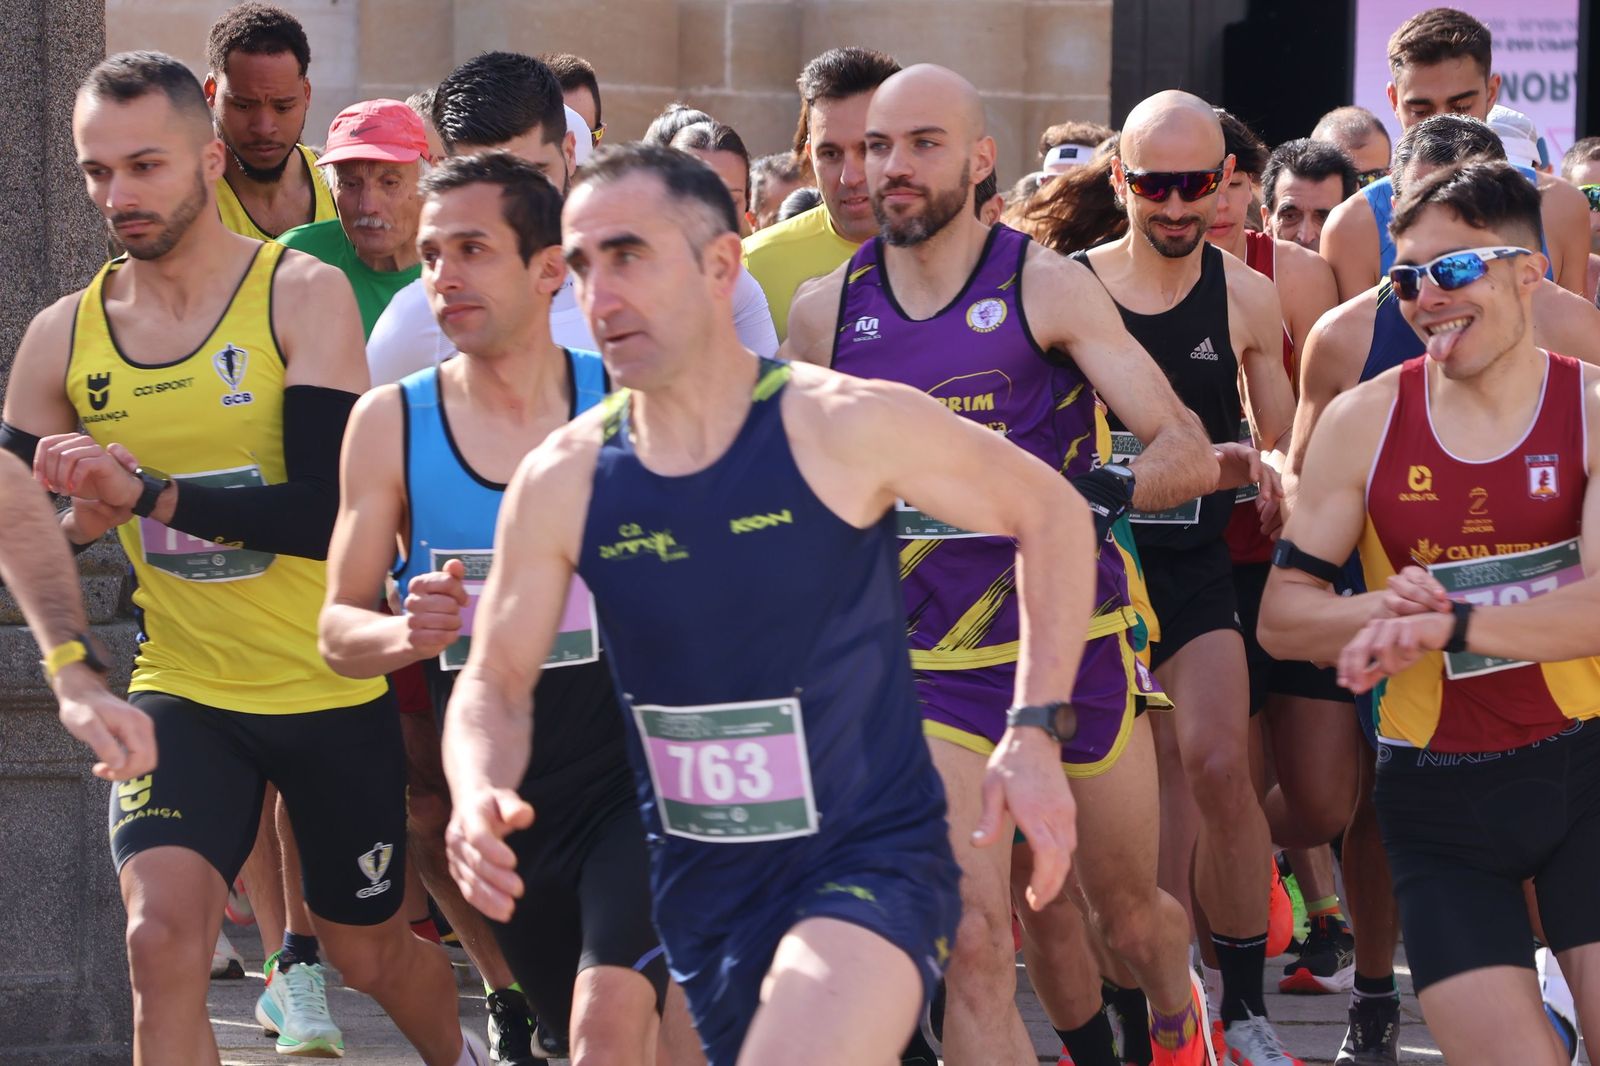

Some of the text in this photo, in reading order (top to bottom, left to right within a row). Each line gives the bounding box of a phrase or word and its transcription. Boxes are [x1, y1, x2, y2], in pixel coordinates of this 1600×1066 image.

[1190, 350, 1218, 361] adidas
[155, 377, 195, 393] SPORT
[222, 392, 252, 406] GCB
[666, 742, 773, 801] 763
